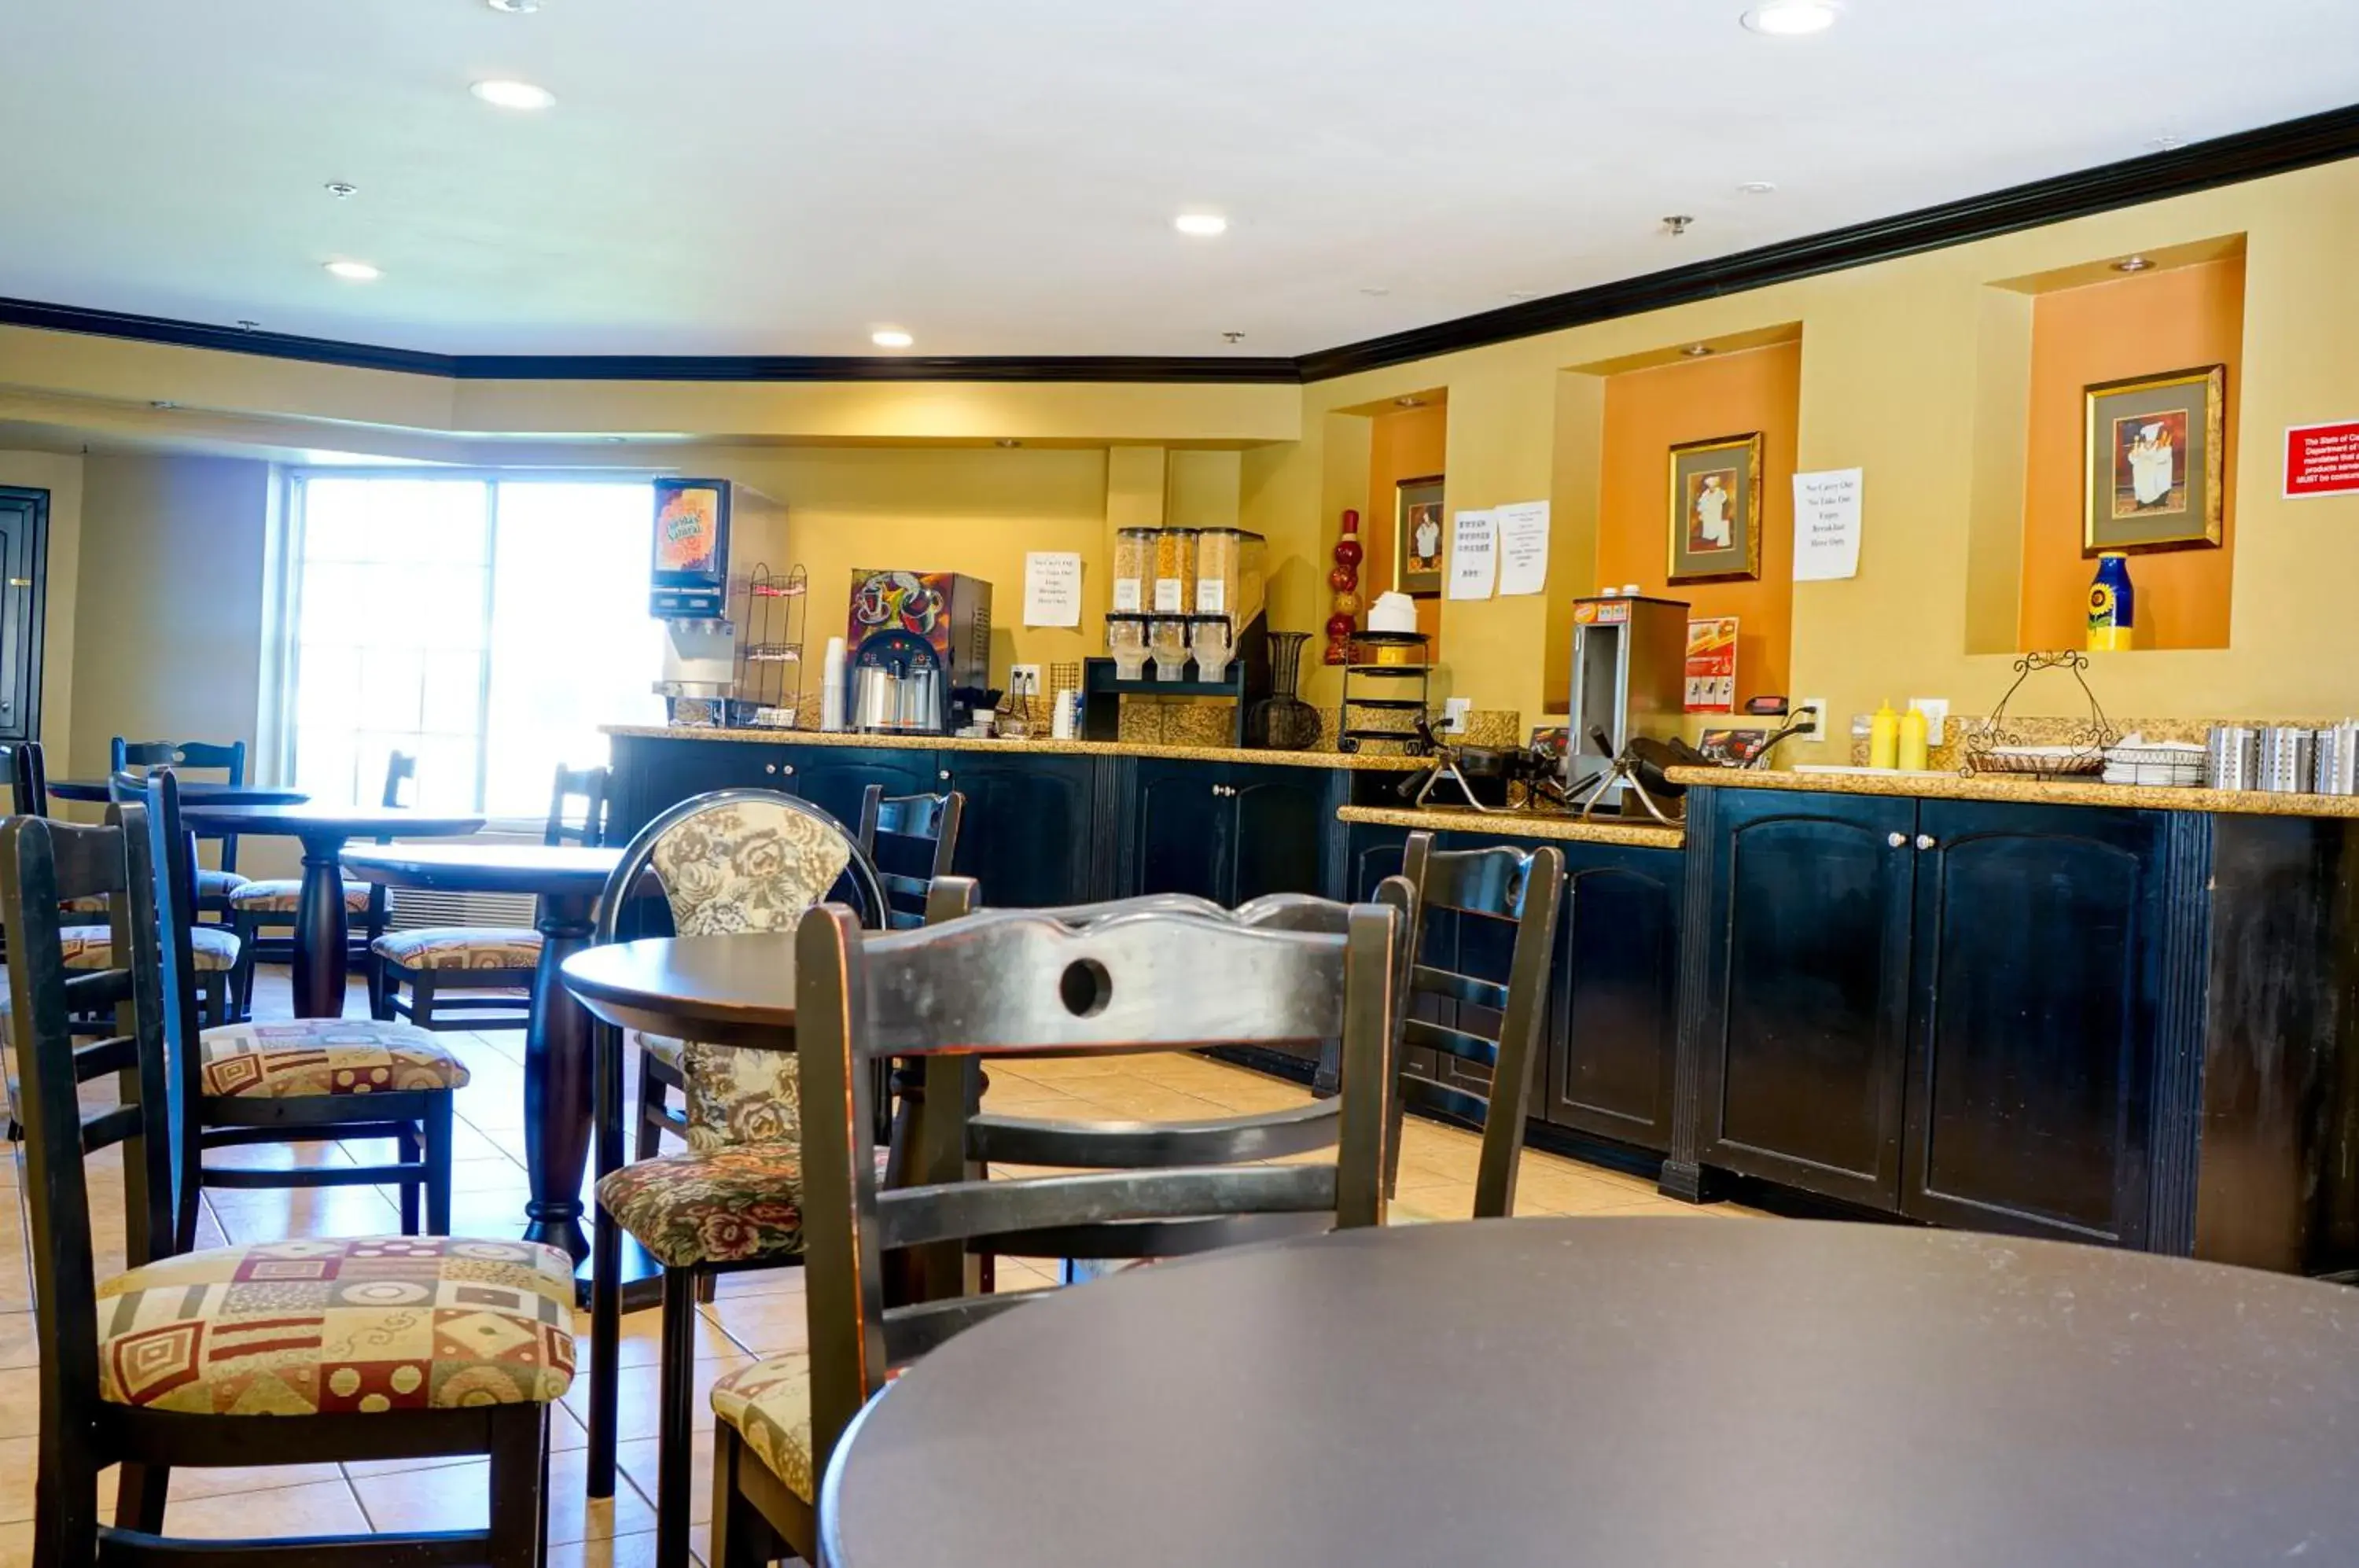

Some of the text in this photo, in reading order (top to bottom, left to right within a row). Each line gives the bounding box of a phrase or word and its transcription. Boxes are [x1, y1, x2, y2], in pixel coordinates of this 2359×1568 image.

[2305, 444, 2347, 456] Department
[2295, 473, 2318, 483] MUST
[2319, 473, 2329, 482] be
